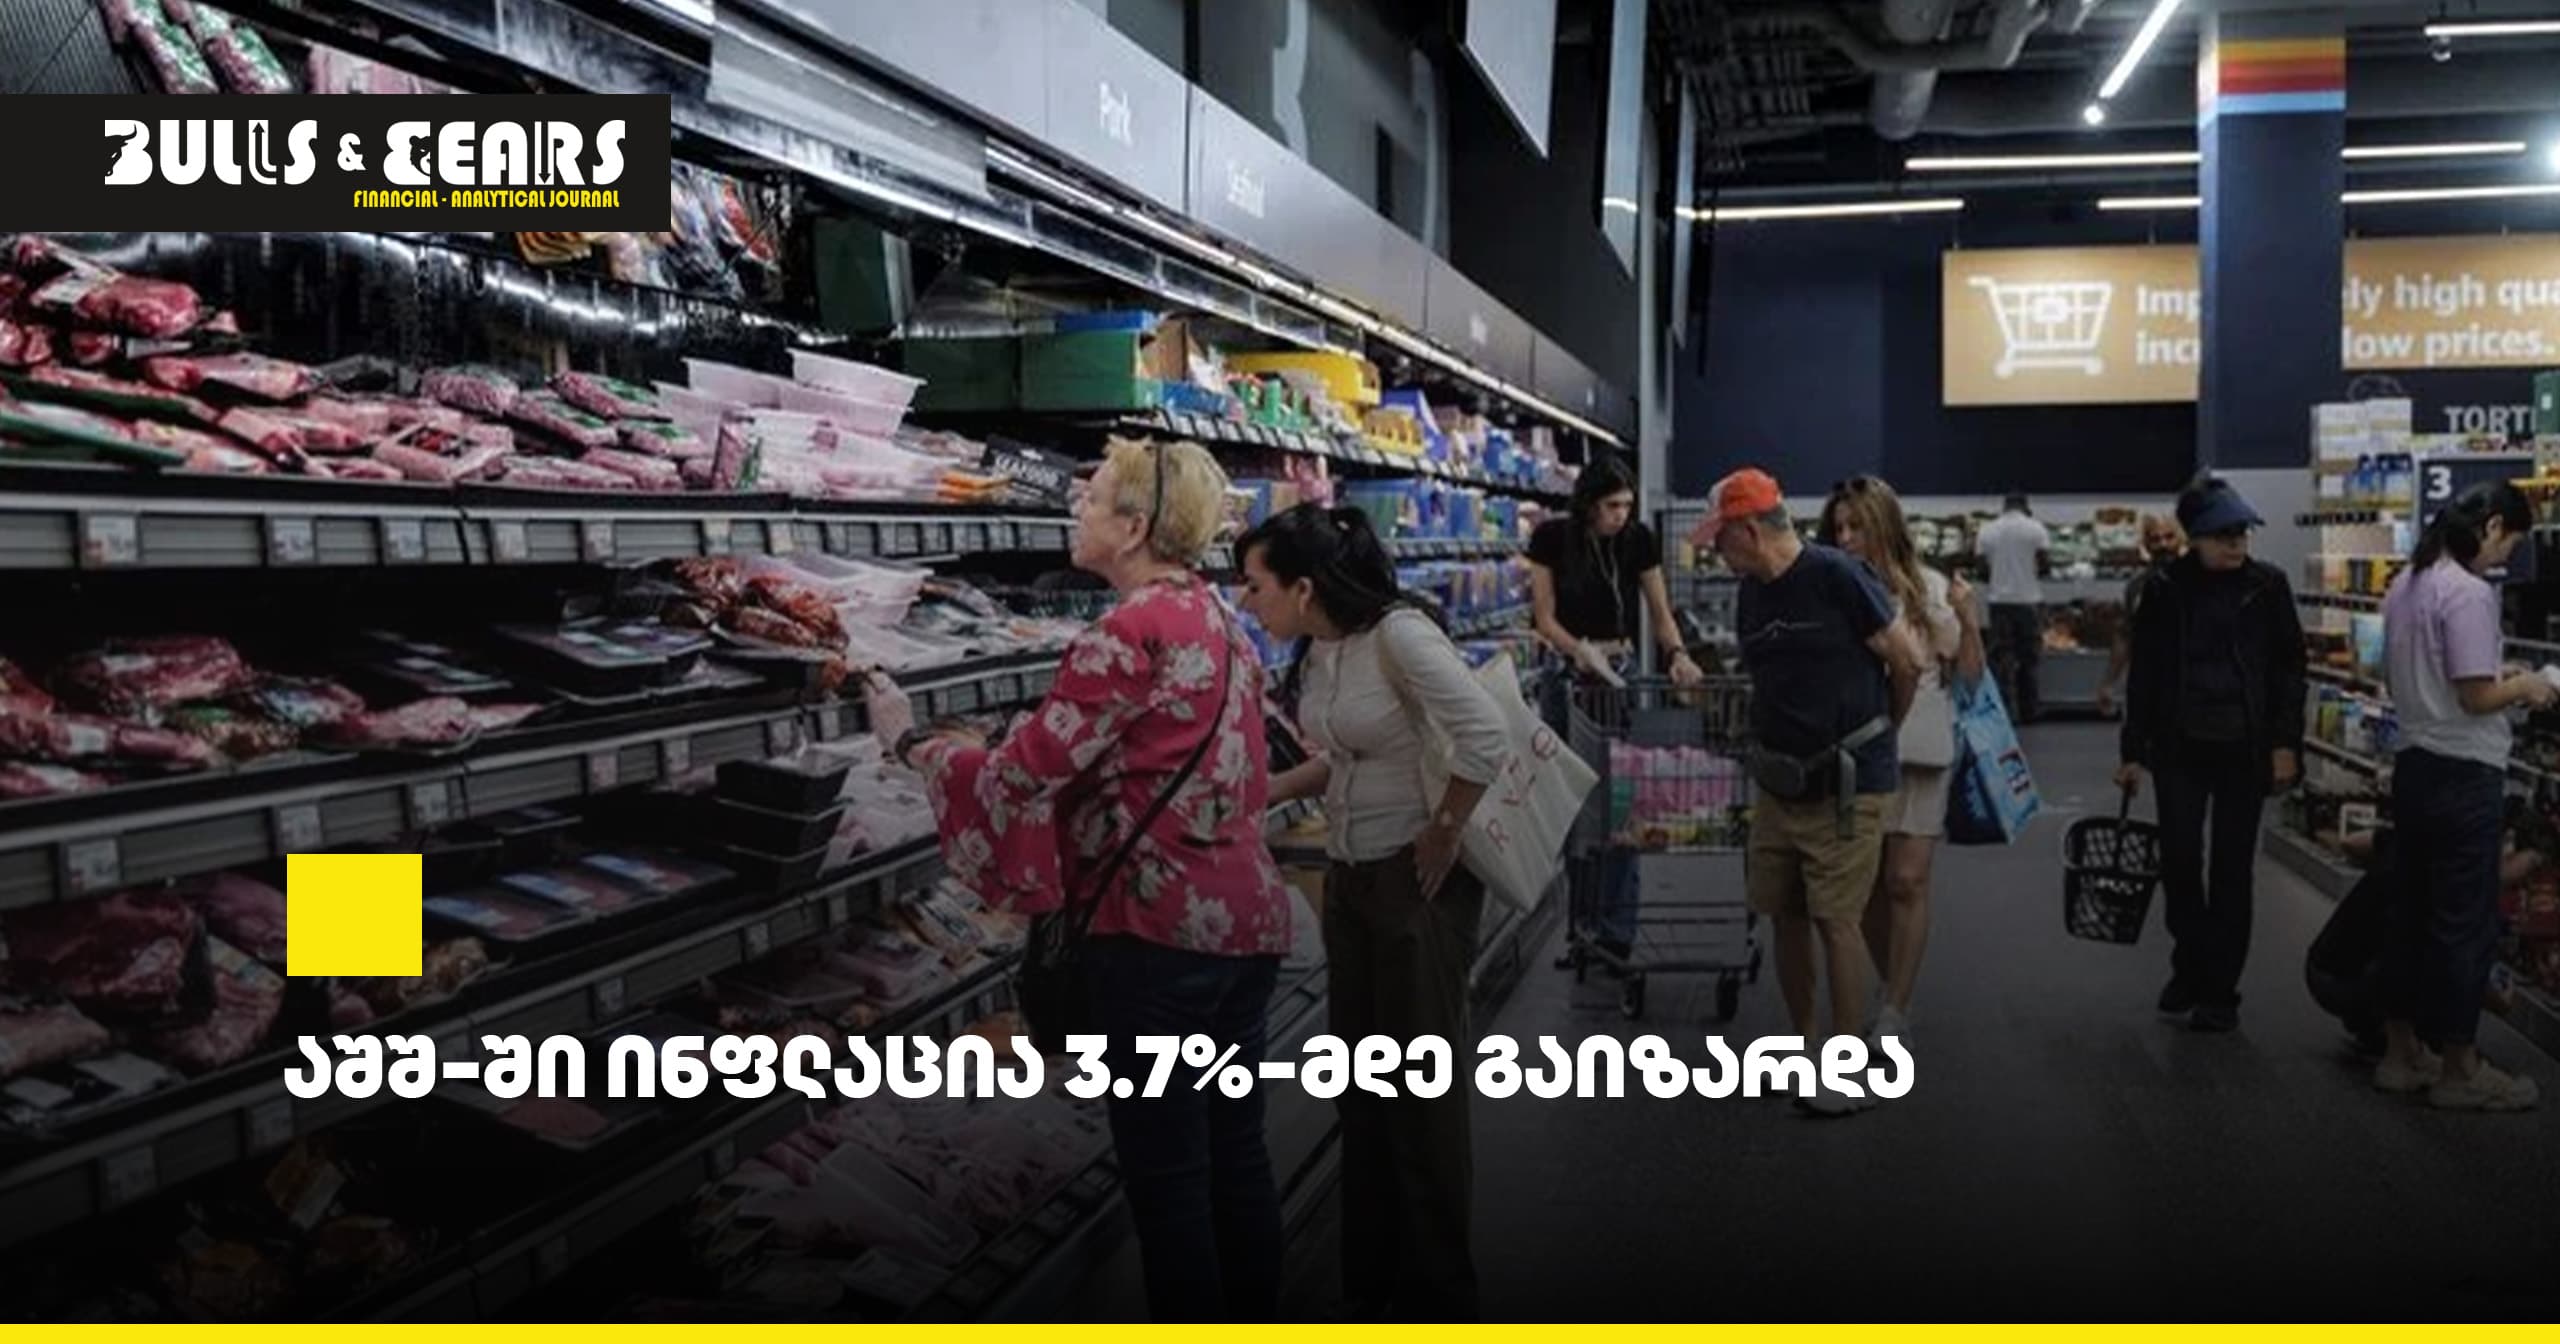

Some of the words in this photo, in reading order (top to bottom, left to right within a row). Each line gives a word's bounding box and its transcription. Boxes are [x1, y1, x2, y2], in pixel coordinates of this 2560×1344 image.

[2395, 274, 2486, 317] high
[2342, 325, 2414, 359] low
[2425, 321, 2556, 366] prices.
[2426, 464, 2452, 500] 3
